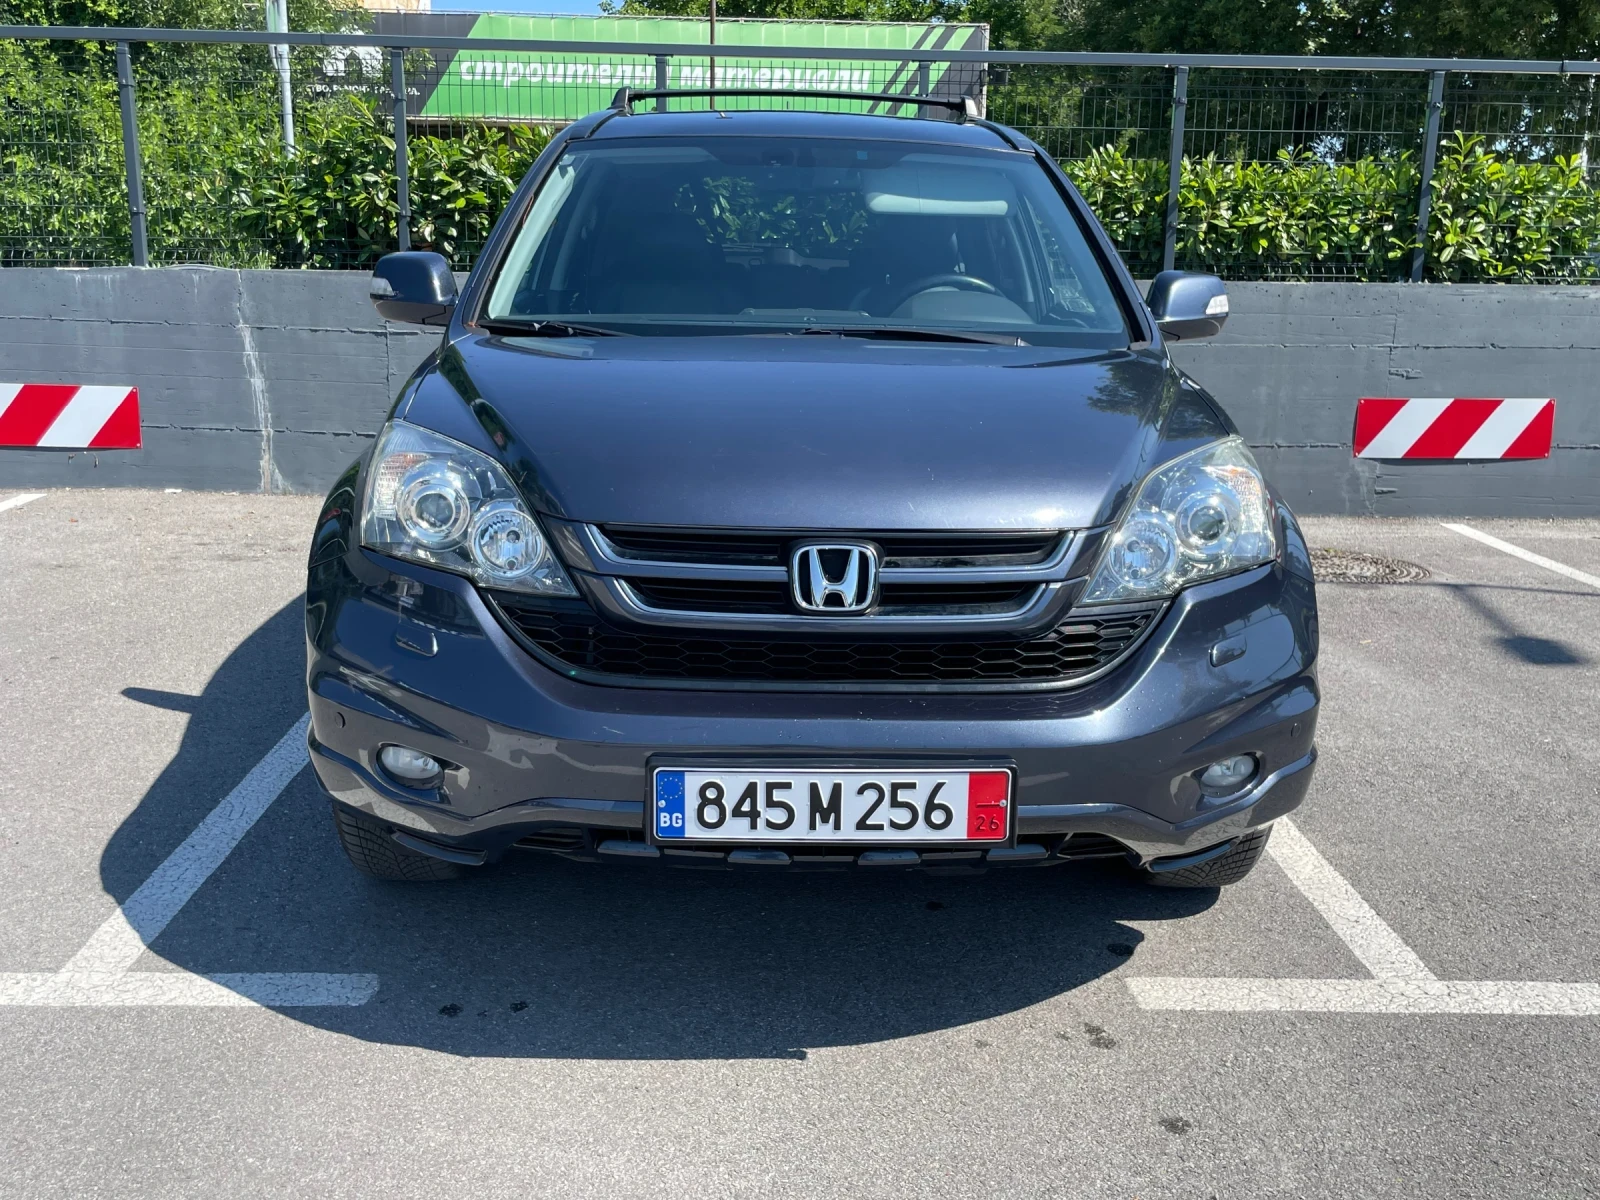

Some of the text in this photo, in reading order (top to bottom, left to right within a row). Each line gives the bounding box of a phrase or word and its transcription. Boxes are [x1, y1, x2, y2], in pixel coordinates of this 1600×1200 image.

[696, 780, 954, 831] 845 M 256
[660, 812, 683, 828] BG
[975, 813, 1000, 832] 26
